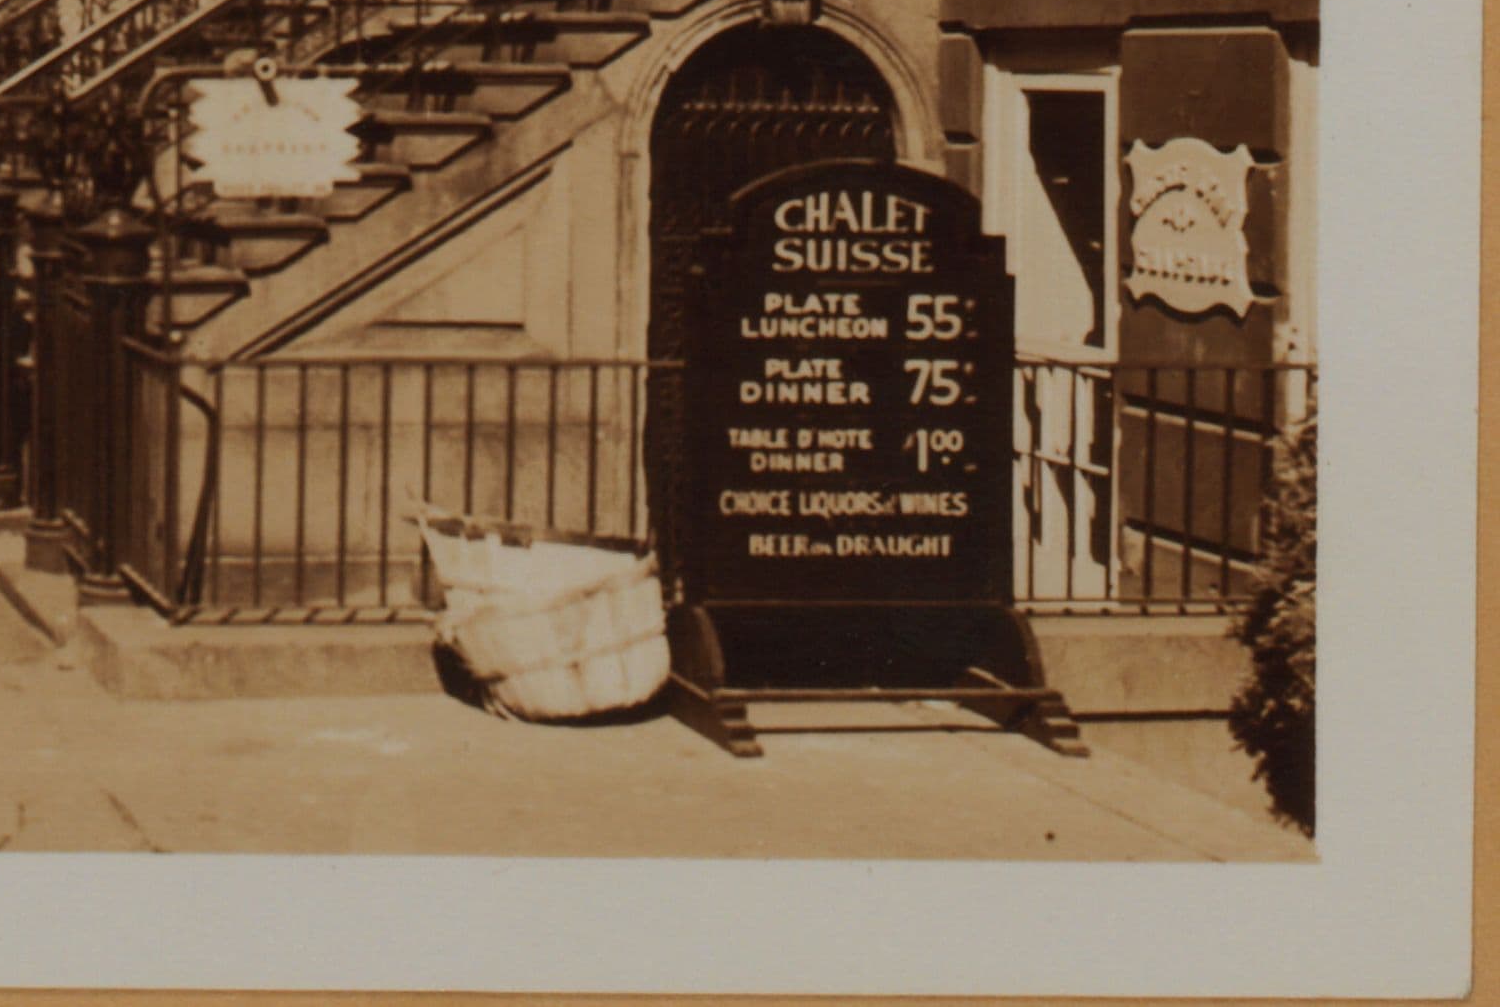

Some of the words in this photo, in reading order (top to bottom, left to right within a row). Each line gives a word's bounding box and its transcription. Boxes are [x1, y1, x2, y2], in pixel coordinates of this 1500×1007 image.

[772, 190, 931, 234] CHALET
[771, 238, 934, 273] SUISSE
[764, 293, 861, 315] PLATE
[741, 317, 889, 340] LUNCHEON
[764, 358, 842, 380] PLATE
[739, 381, 871, 405] DINNER
[727, 427, 789, 449] TABLE
[750, 452, 844, 472] DINNER
[719, 490, 791, 516] CHOICE
[799, 491, 880, 520] LIQUORS
[899, 491, 969, 517] WINES
[748, 534, 809, 557] BEER
[836, 534, 951, 557] DRAUGHT
